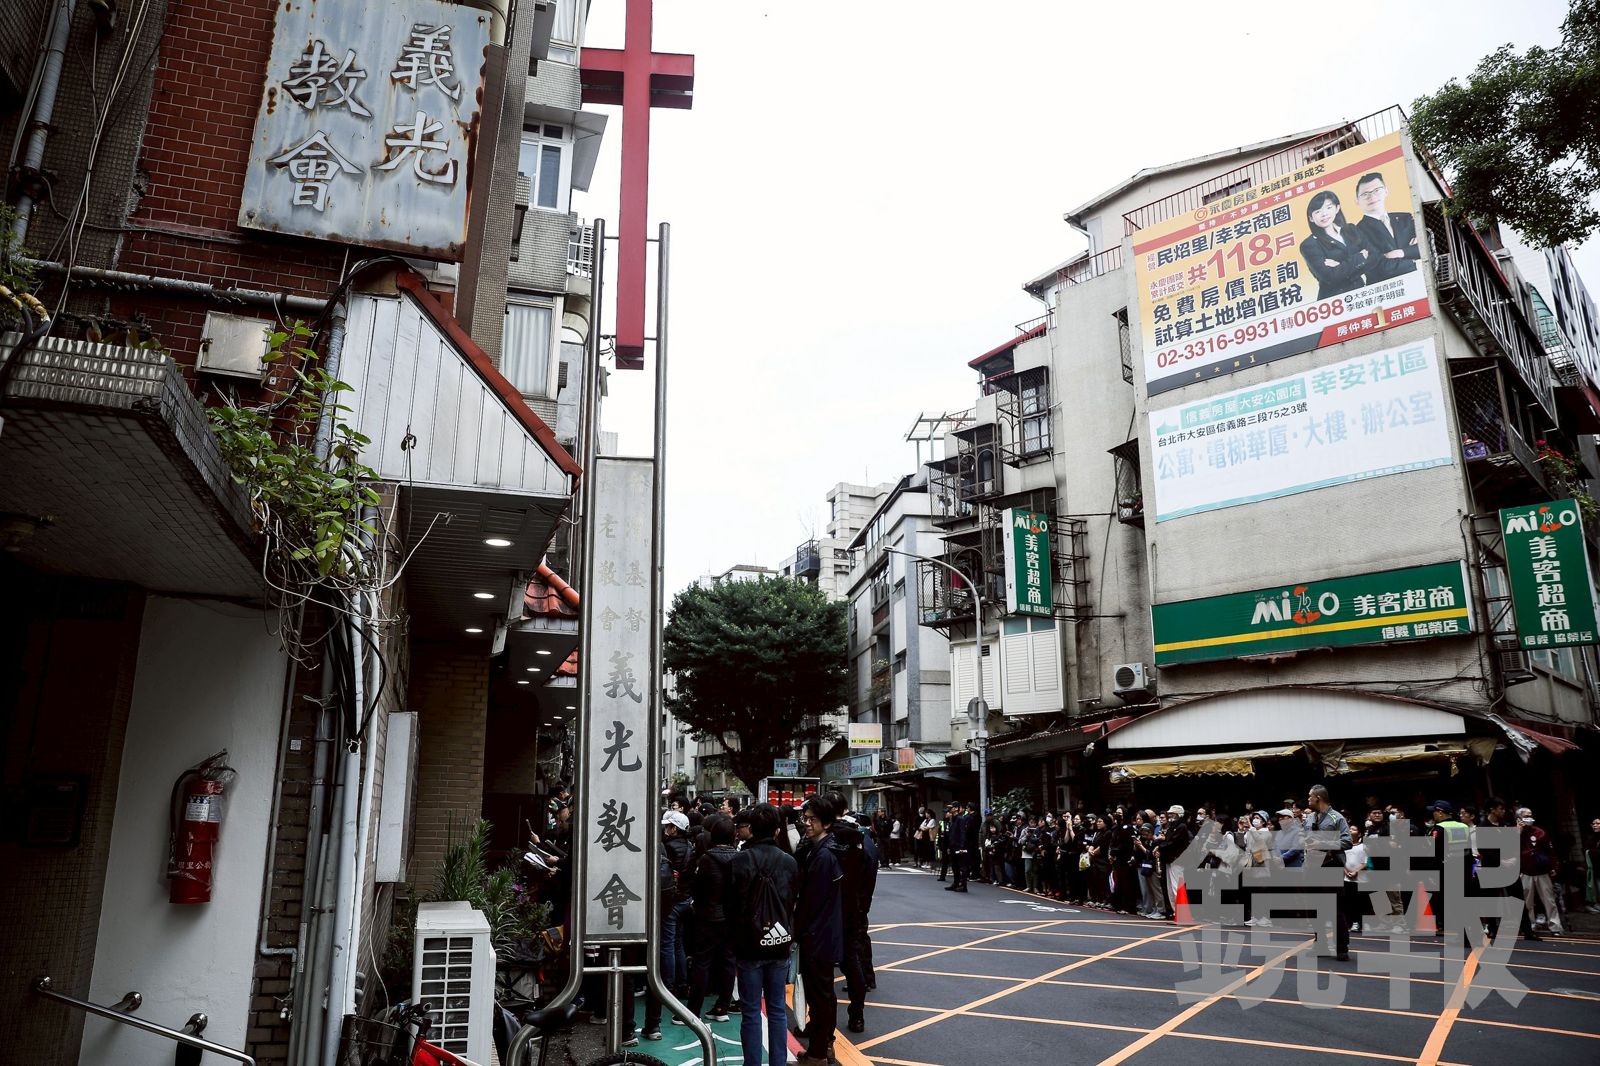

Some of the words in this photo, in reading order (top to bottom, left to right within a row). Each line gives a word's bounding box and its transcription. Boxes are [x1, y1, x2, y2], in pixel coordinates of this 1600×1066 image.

[1294, 163, 1326, 182] 再成交
[1154, 283, 1303, 347] 試算土地增值稅
[1311, 345, 1429, 397] 幸安社區
[1157, 401, 1308, 448] 台北市大安區信義路三段75之3號
[1025, 534, 1042, 604] 美客超商
[1528, 535, 1571, 632] 美客超商
[1353, 585, 1456, 617] 美客超商
[1381, 624, 1410, 640] 信義
[1413, 620, 1459, 637] 協榮店
[1524, 634, 1549, 646] 信義
[760, 934, 792, 946] adidas
